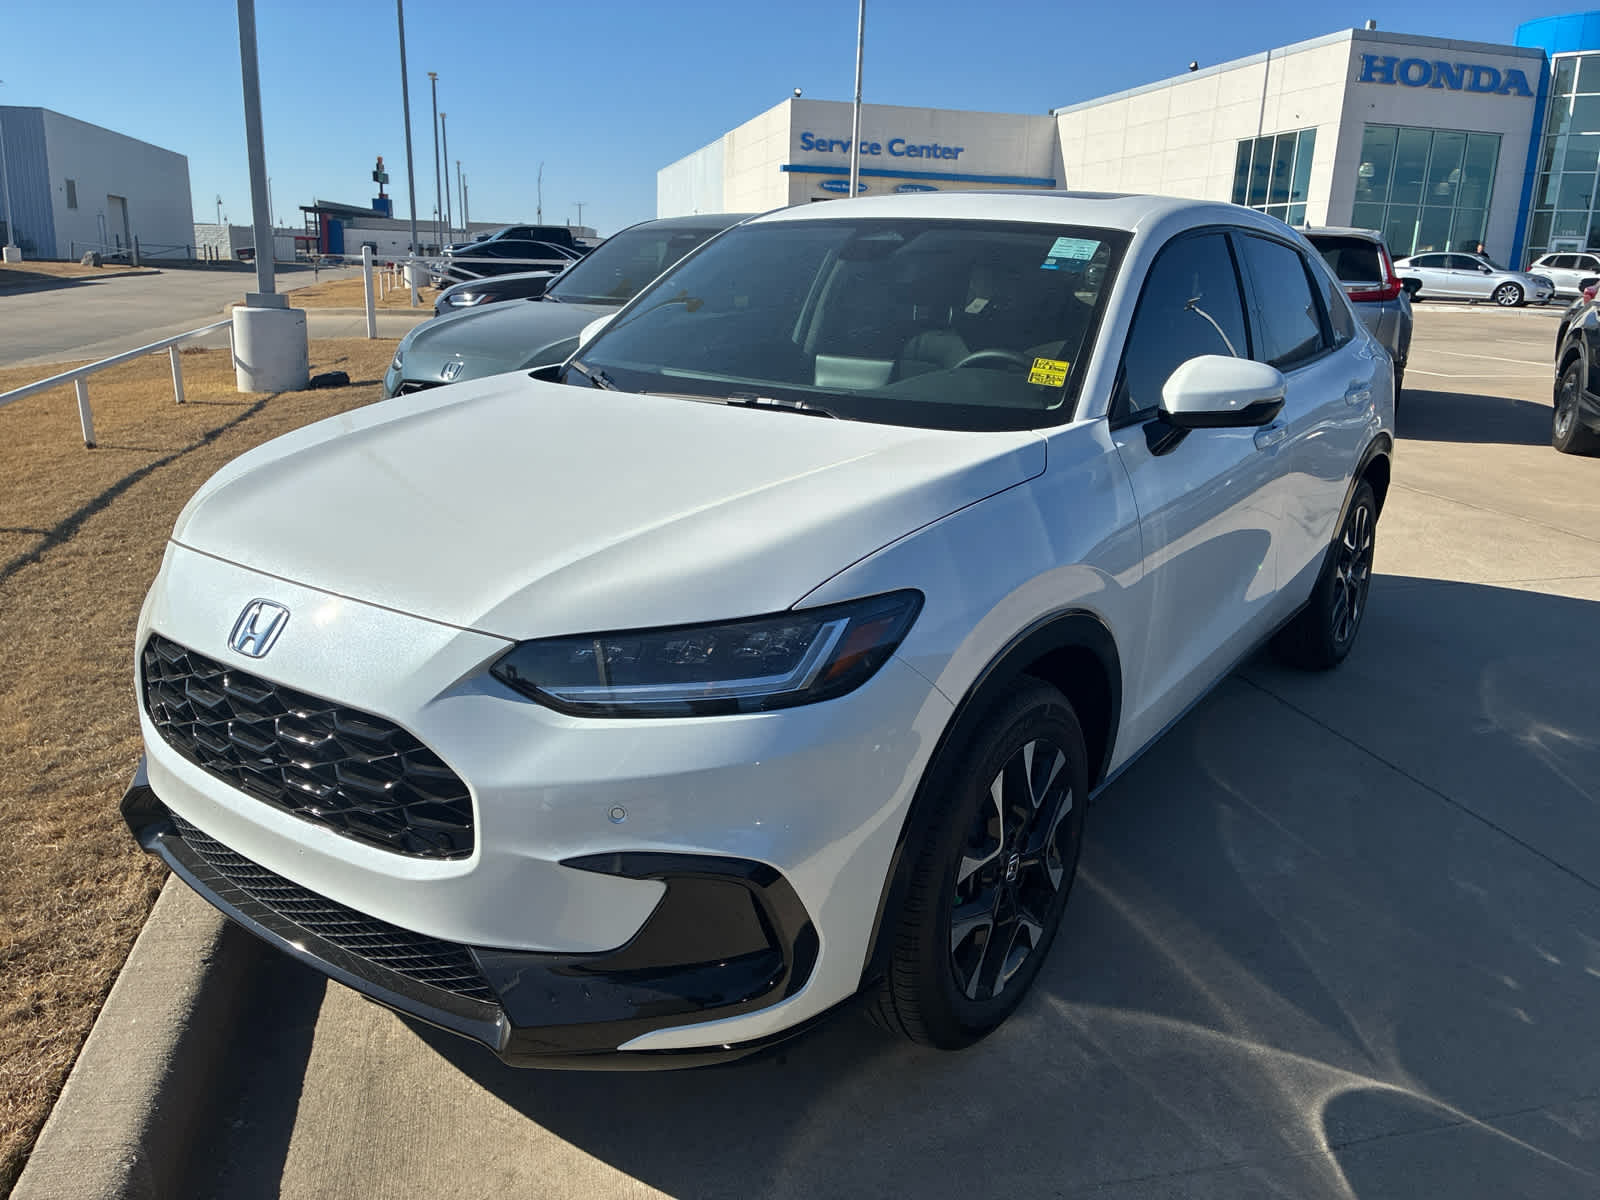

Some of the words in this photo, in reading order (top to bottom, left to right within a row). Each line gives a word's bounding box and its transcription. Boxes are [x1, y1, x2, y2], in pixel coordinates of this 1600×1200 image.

[1358, 54, 1535, 97] HONDA
[800, 131, 882, 155] Servce
[888, 138, 965, 160] Center
